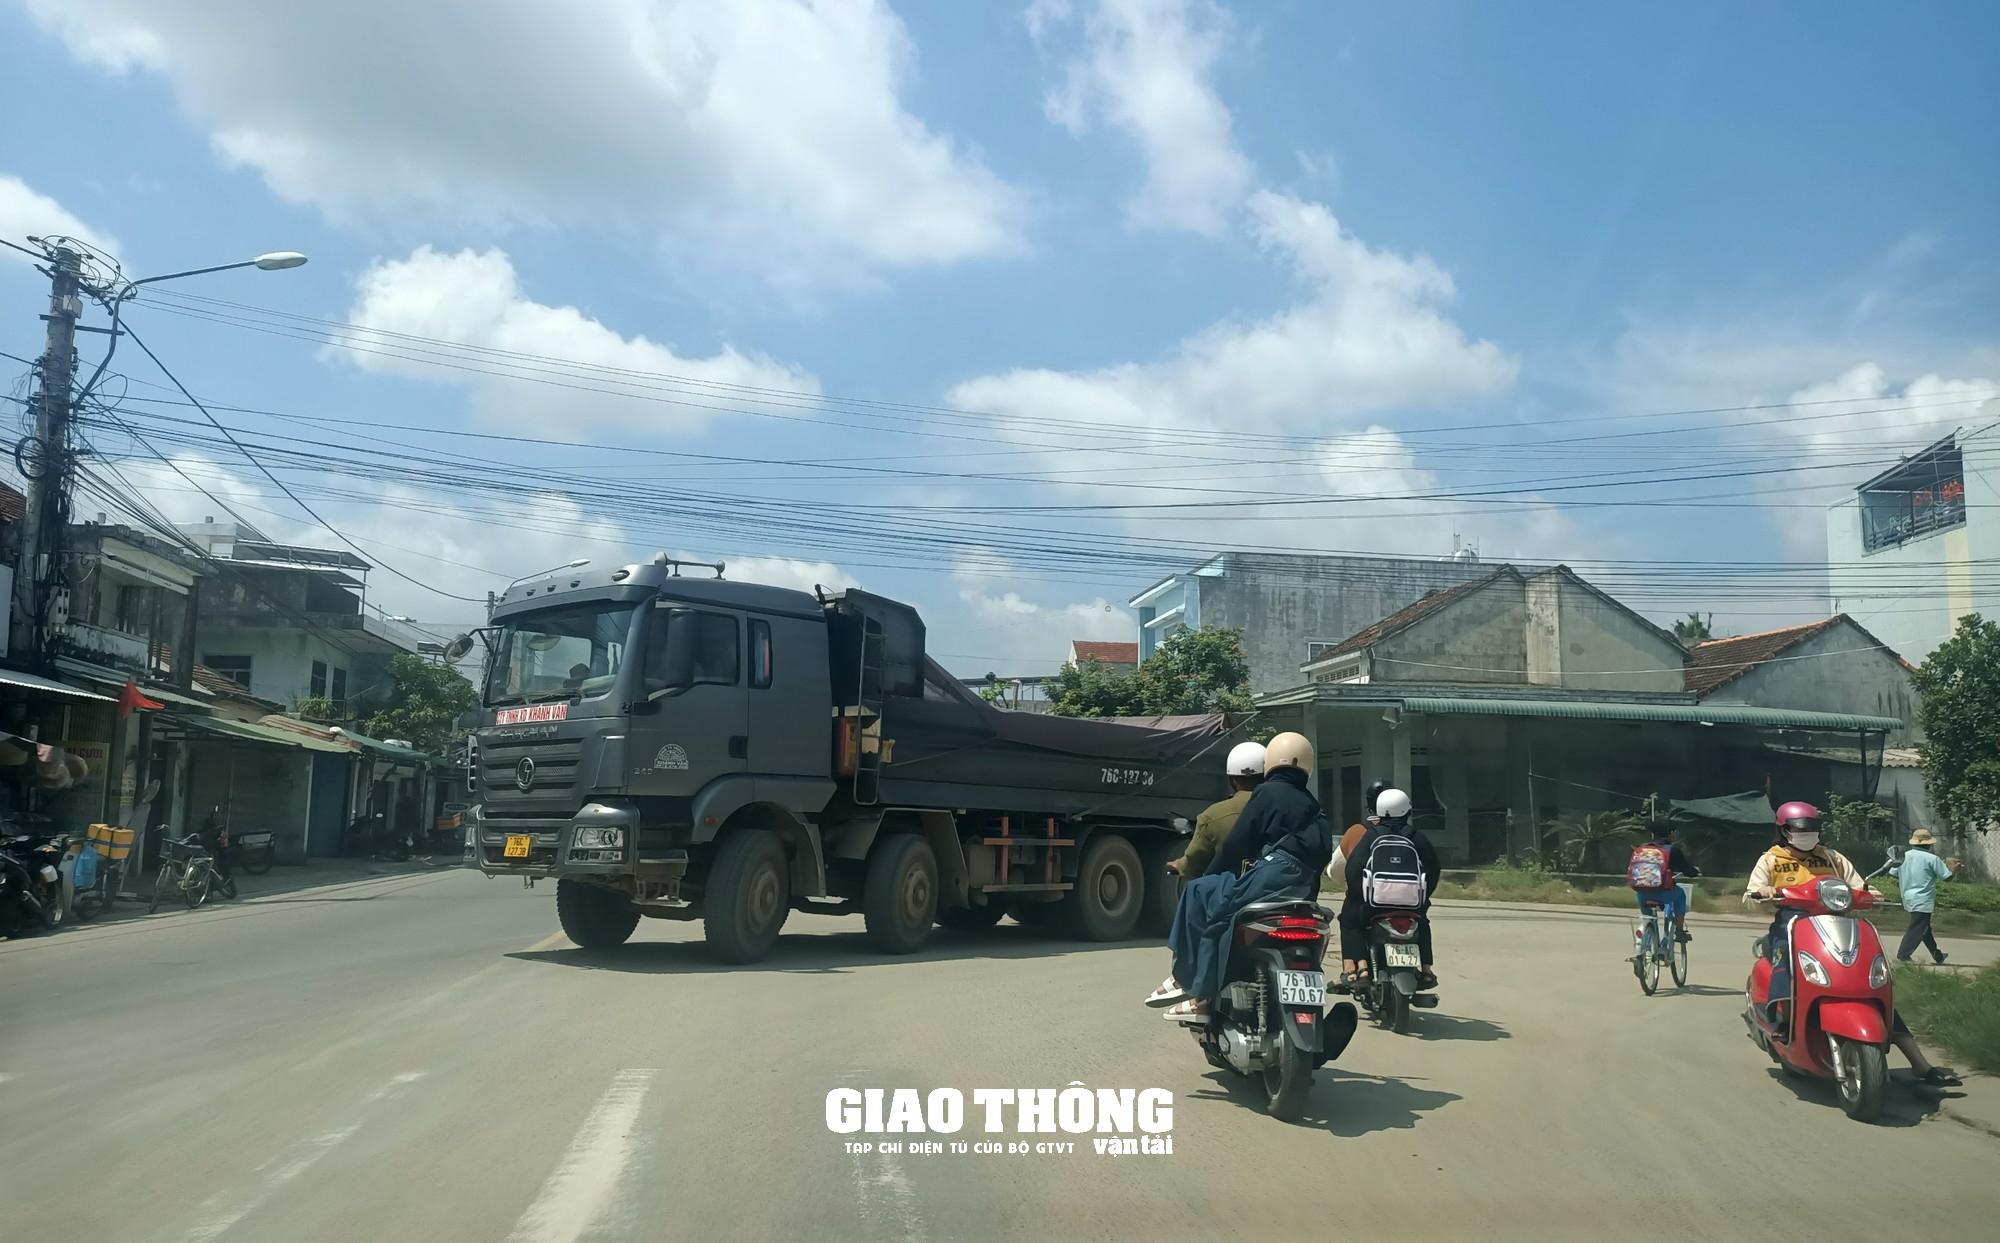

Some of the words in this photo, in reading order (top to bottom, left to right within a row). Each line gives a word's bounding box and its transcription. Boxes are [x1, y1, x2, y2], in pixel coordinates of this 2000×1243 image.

[528, 704, 551, 720] KHÁNH
[513, 837, 523, 846] 76C
[1391, 945, 1415, 956] 76-AC
[1284, 973, 1317, 988] 76-D1
[1281, 987, 1324, 1003] 570.67
